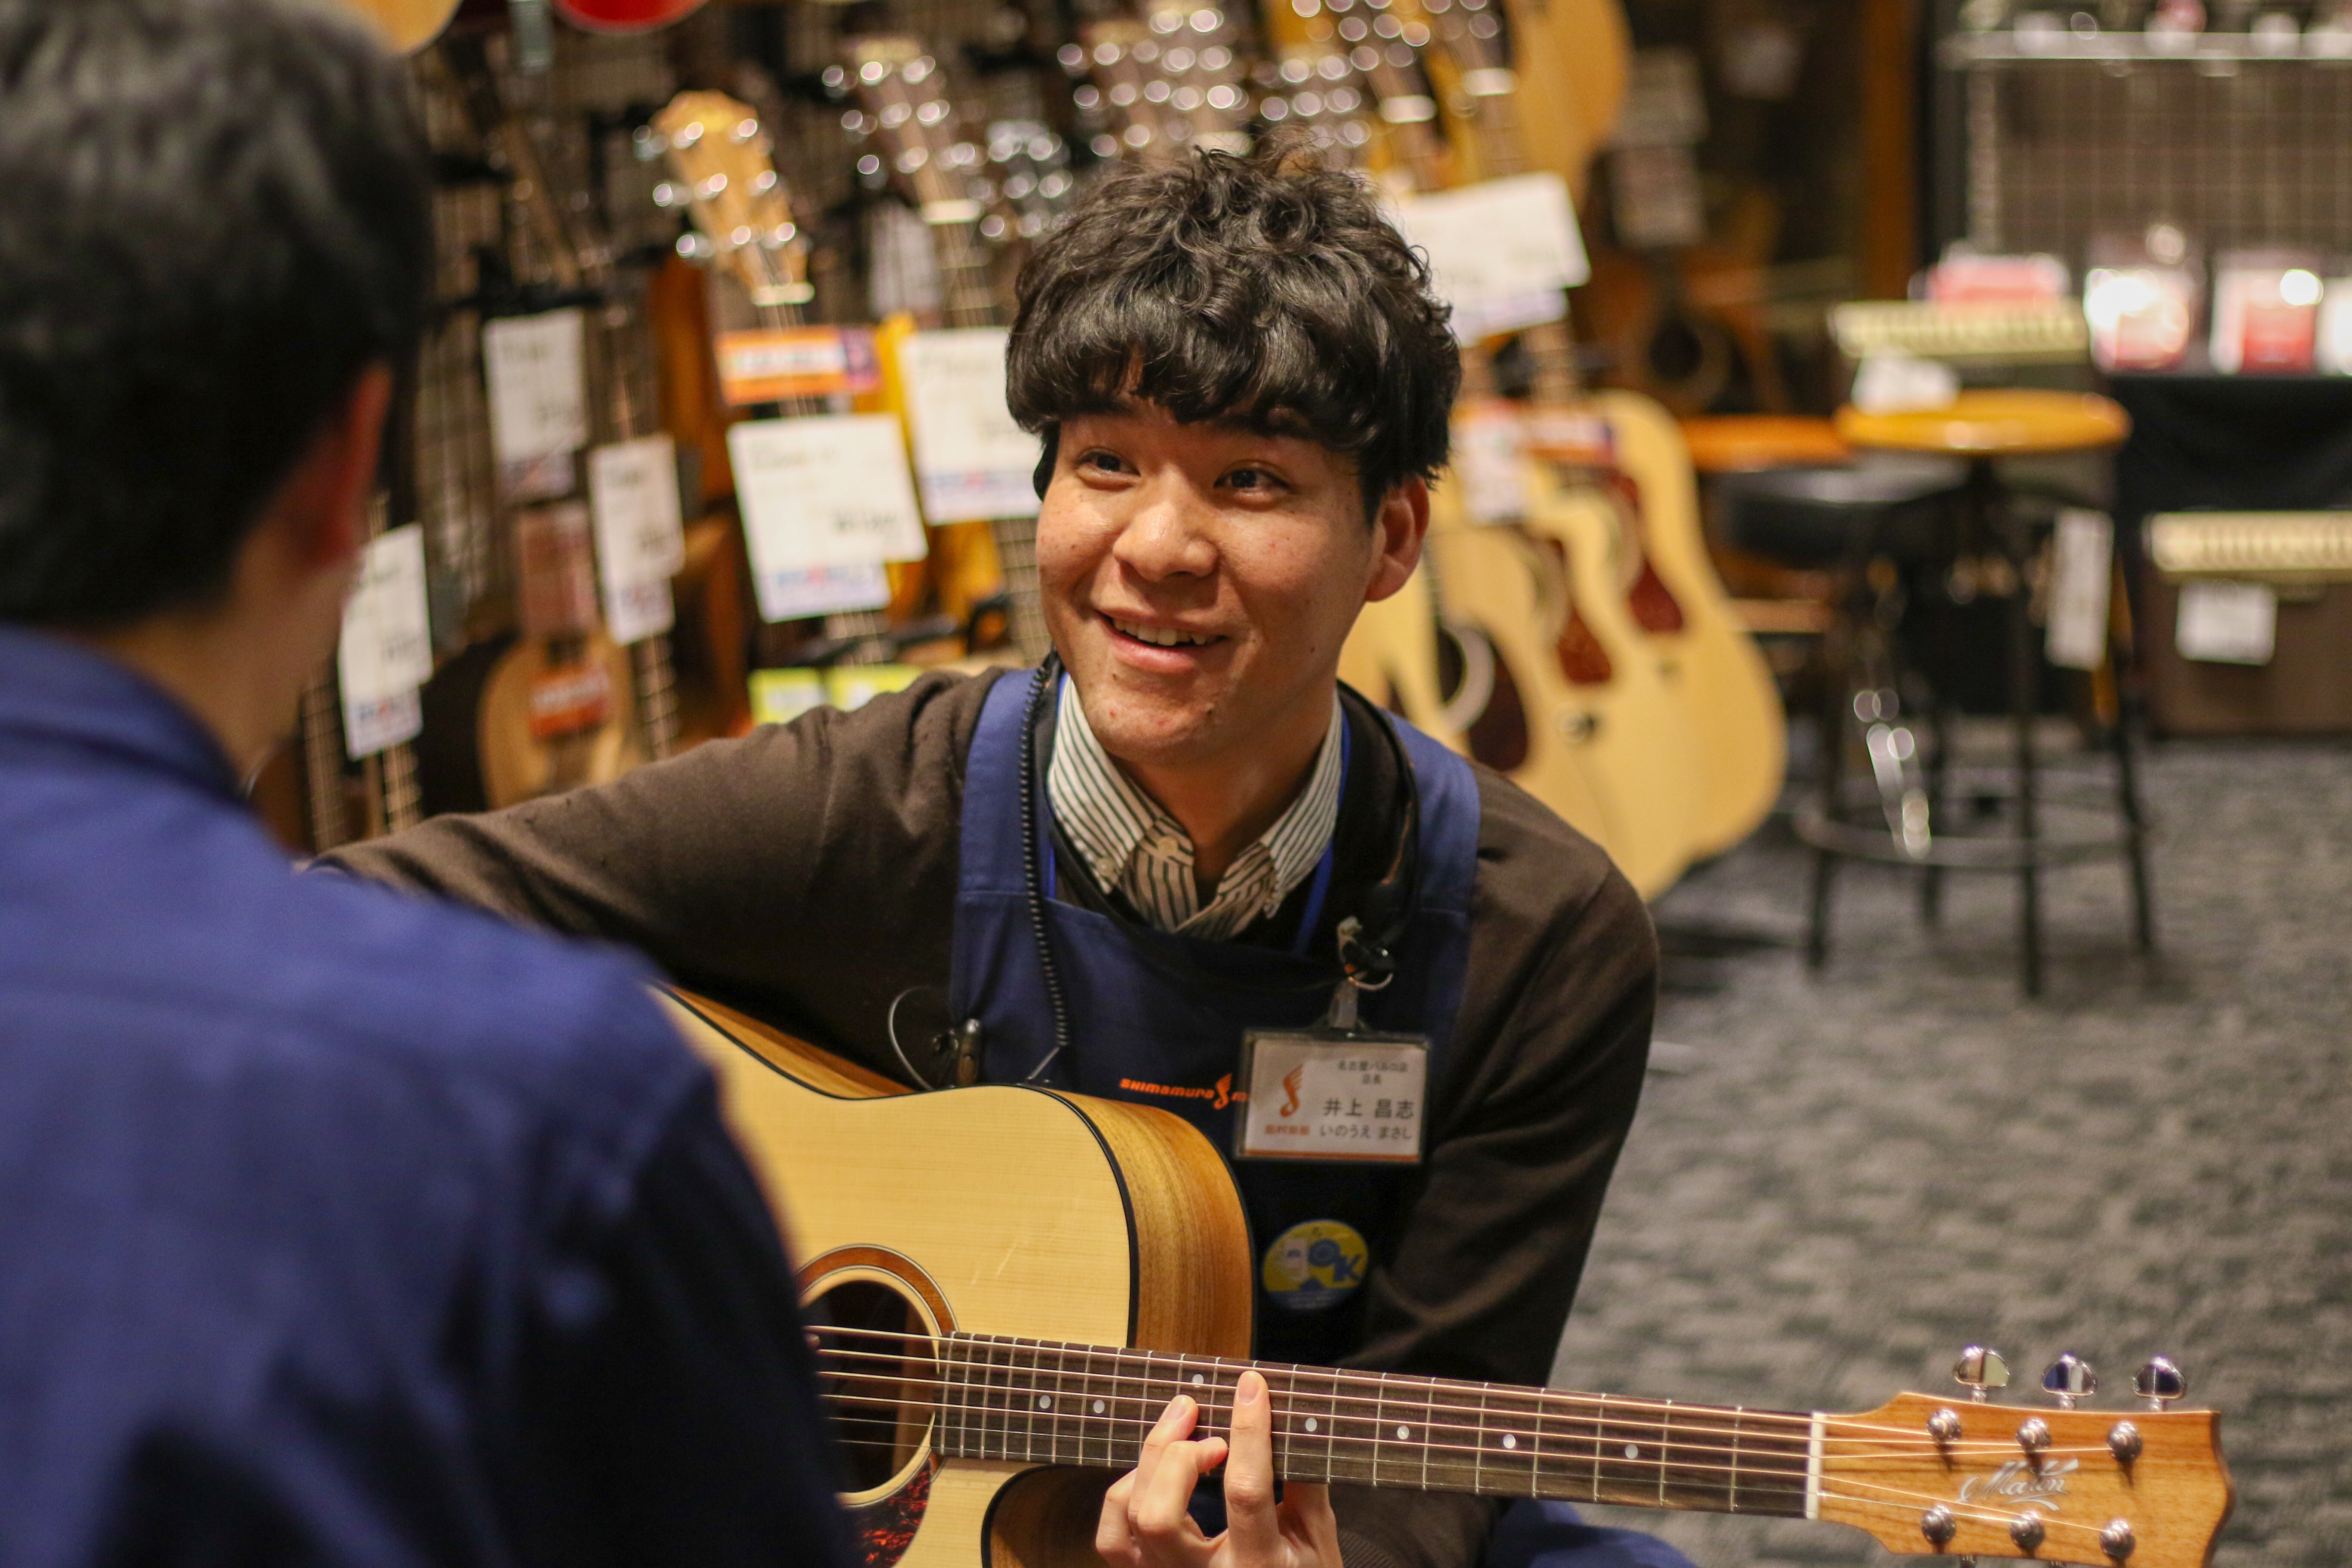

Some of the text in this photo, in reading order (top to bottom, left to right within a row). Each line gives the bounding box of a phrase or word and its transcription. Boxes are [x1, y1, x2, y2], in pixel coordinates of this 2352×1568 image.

[1323, 1097, 1415, 1119] 井上 昌志
[1320, 1124, 1412, 1140] いのうえ まさし
